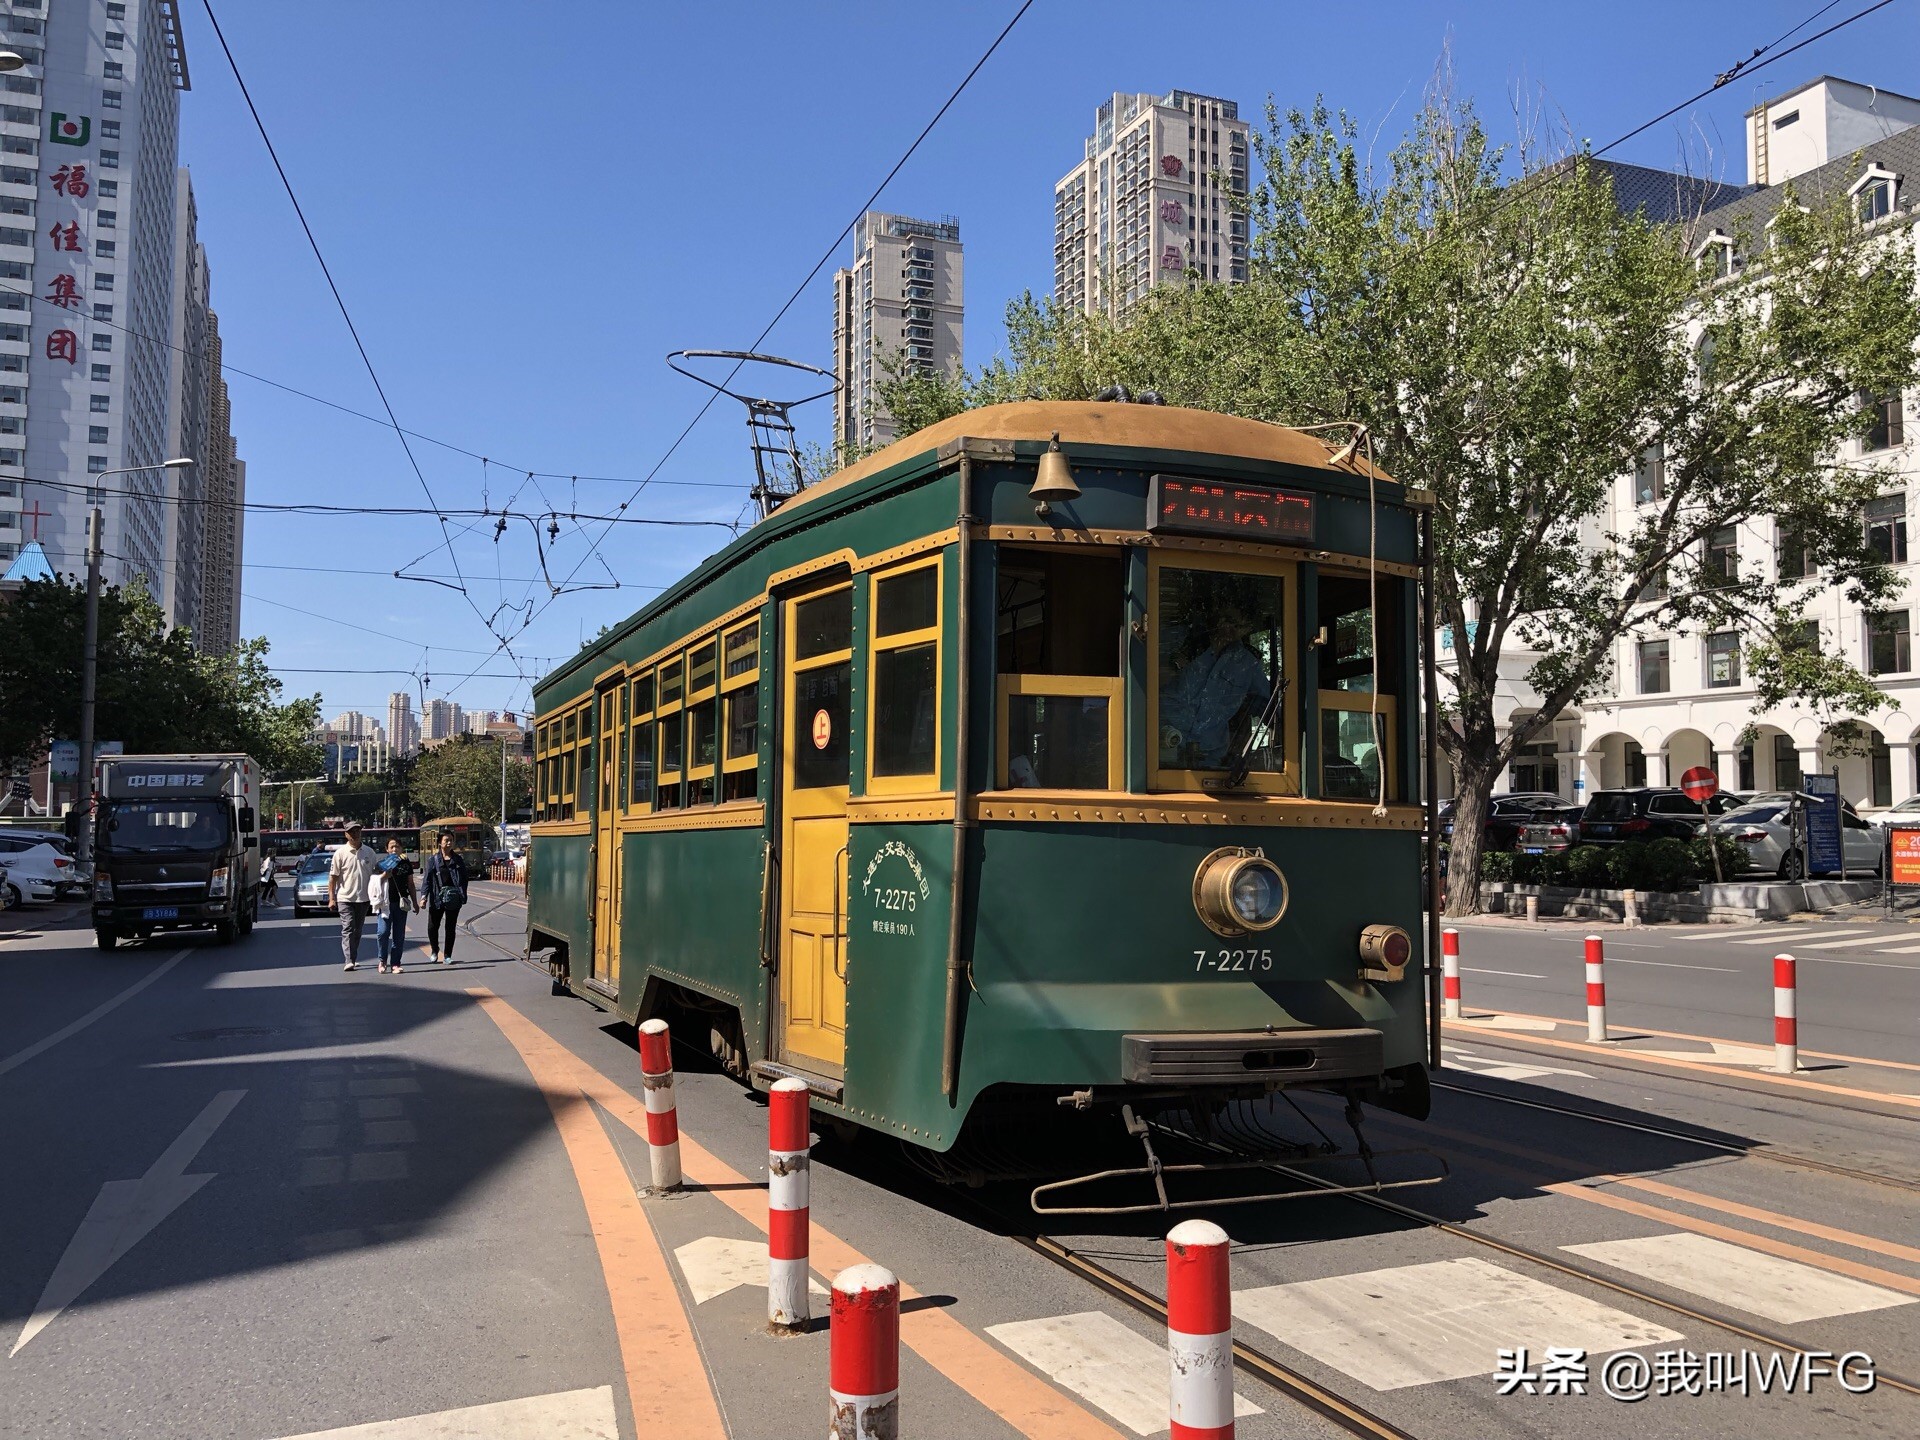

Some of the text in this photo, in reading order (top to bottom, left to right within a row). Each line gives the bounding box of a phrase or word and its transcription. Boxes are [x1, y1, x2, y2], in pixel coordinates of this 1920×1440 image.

[45, 164, 90, 365] 福佳集团
[127, 774, 205, 788] 中国重汽
[874, 888, 916, 912] 7-2275
[1193, 949, 1273, 972] 7-2275
